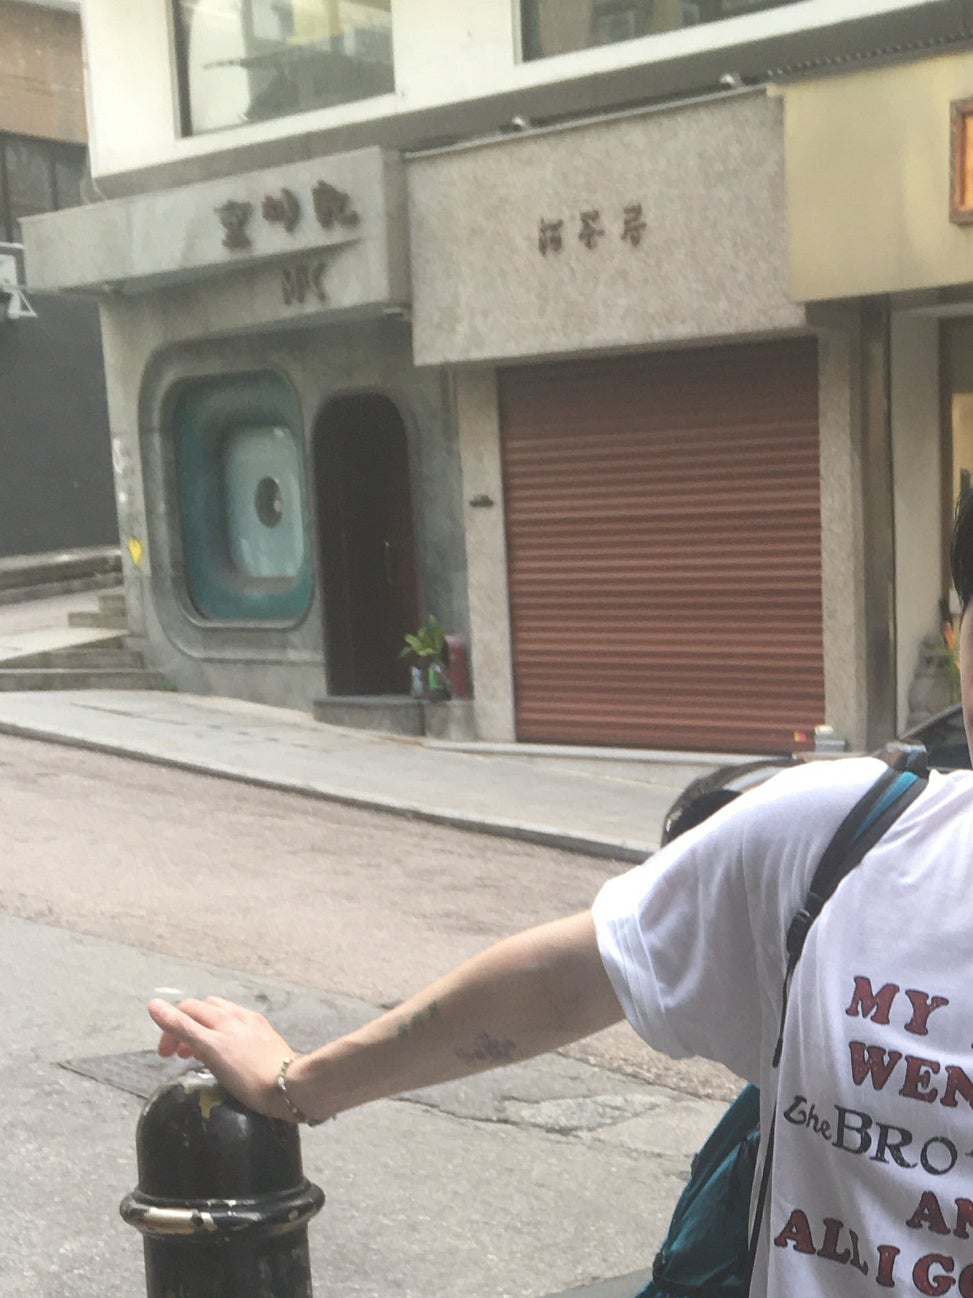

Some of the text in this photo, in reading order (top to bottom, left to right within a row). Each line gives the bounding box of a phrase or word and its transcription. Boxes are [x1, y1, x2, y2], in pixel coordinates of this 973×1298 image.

[845, 976, 949, 1036] MY
[774, 1209, 869, 1276] ALL
[876, 1245, 900, 1287] I
